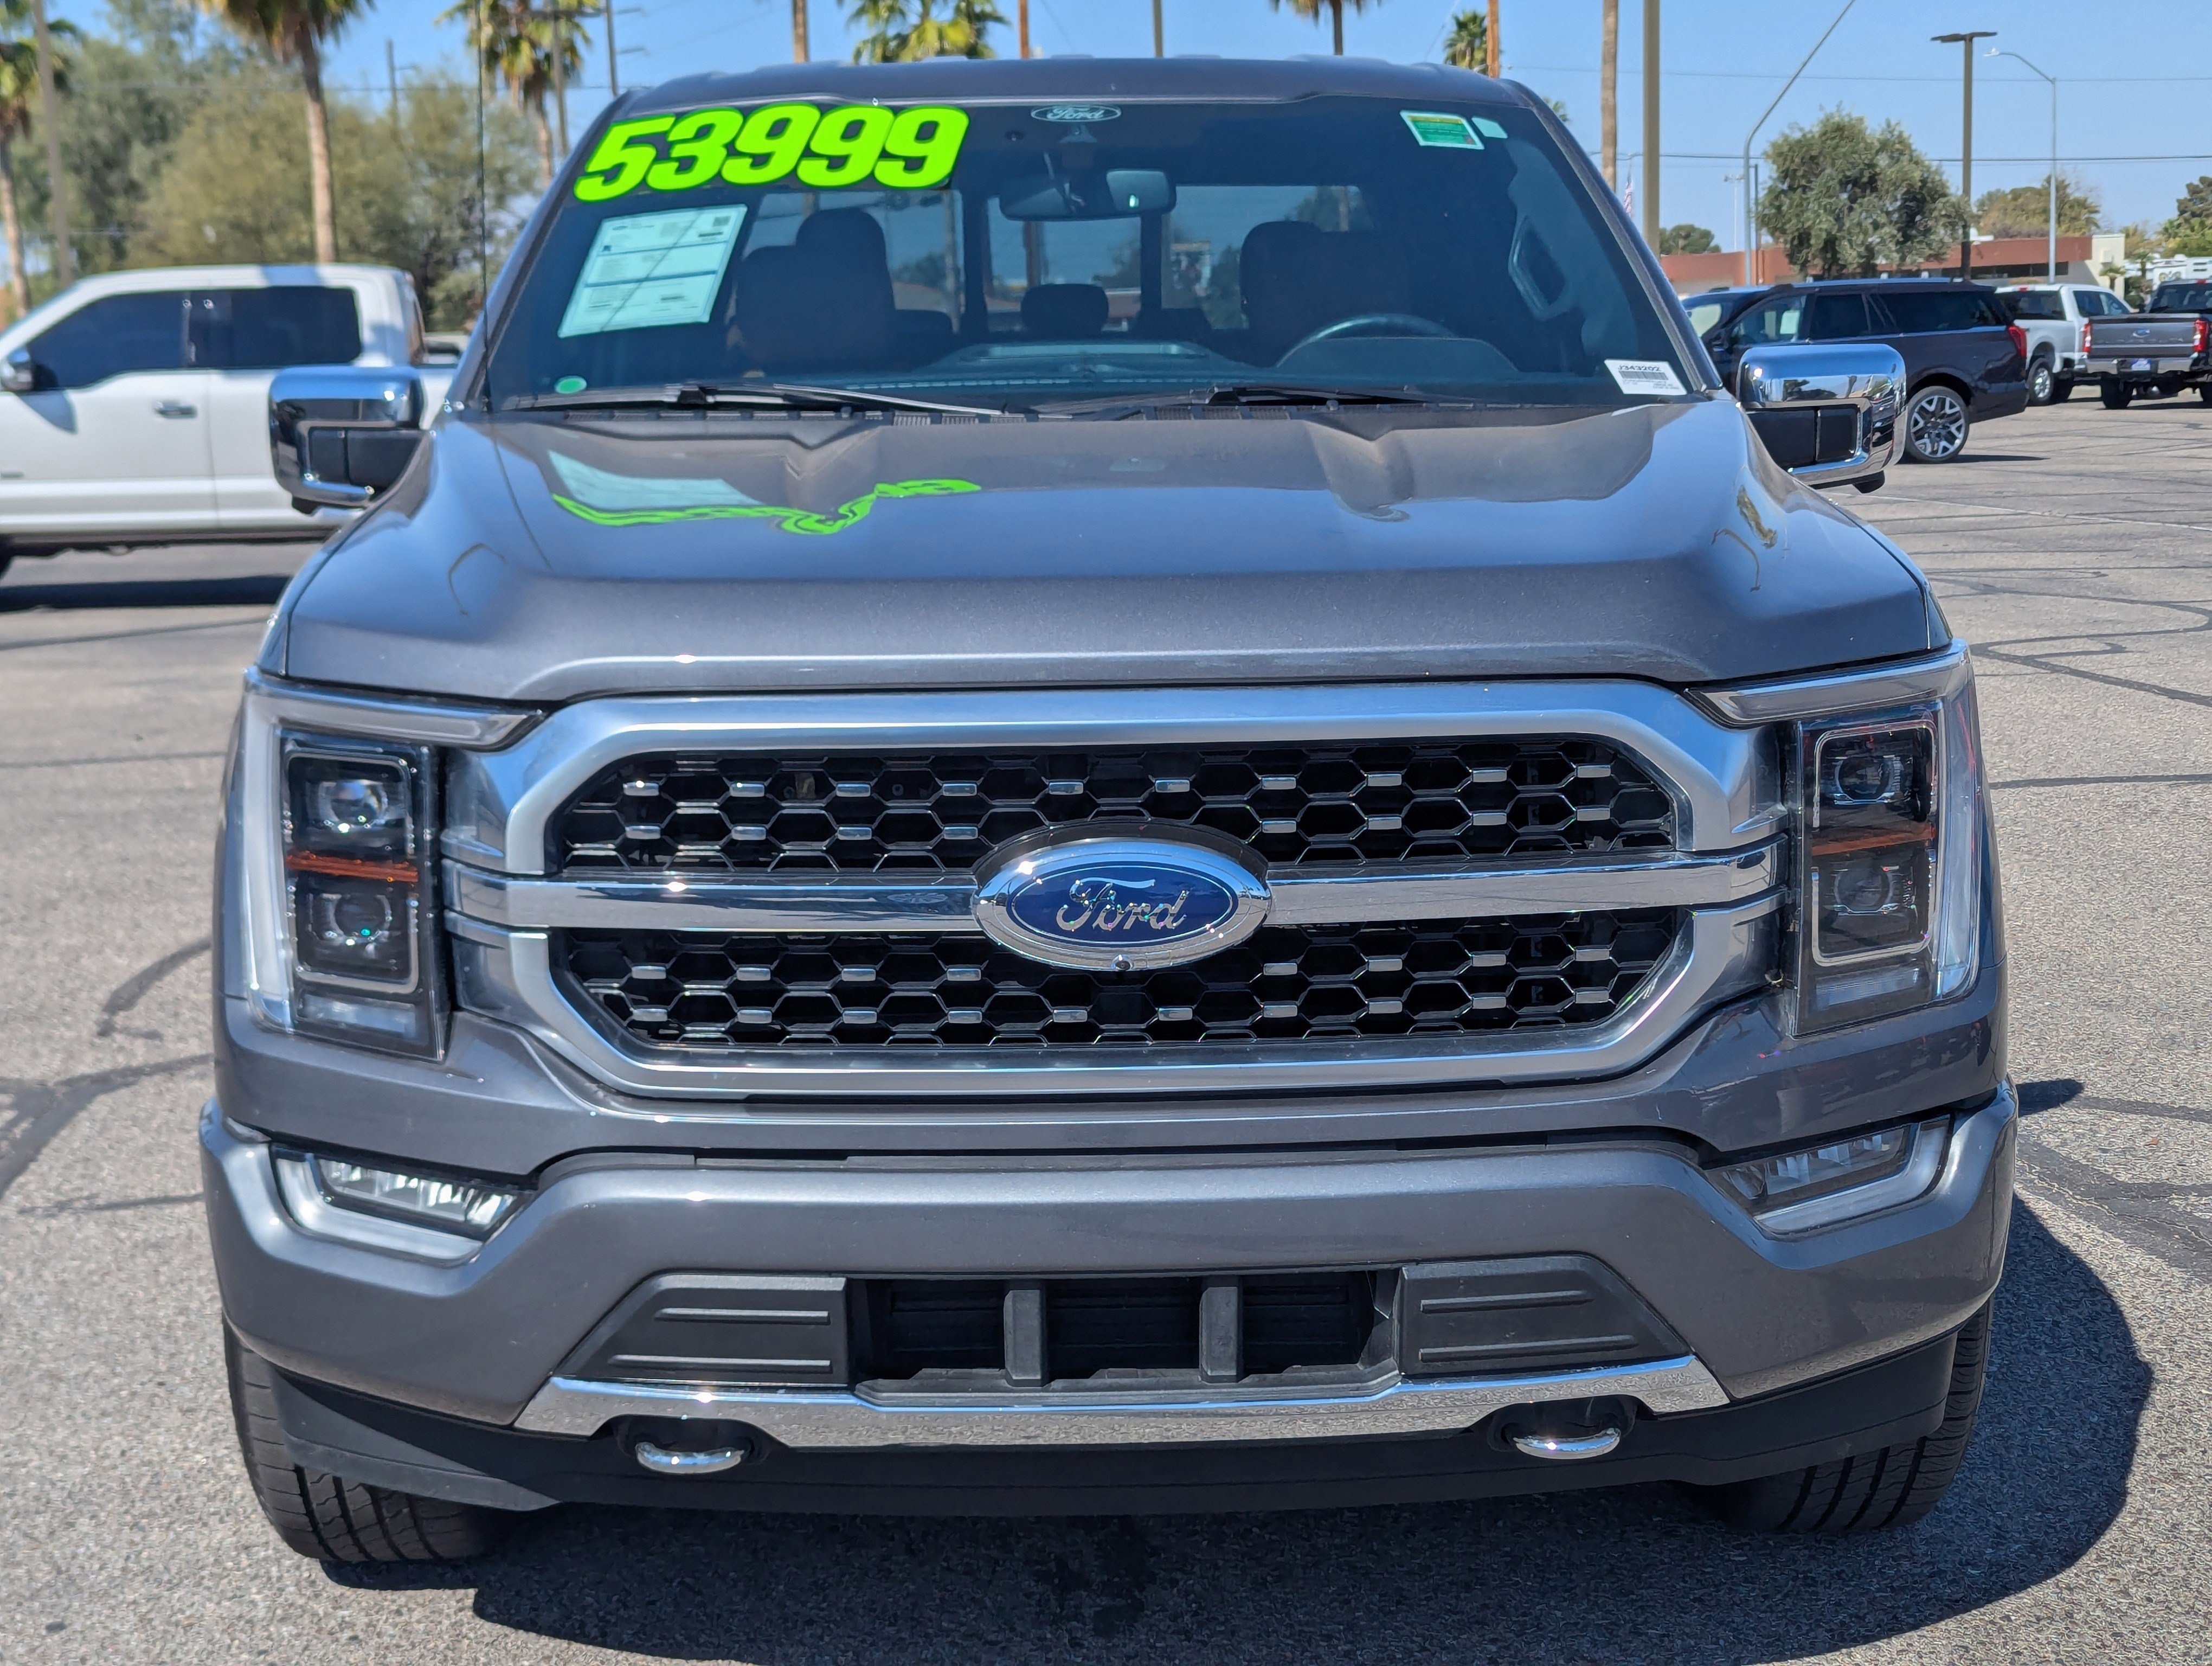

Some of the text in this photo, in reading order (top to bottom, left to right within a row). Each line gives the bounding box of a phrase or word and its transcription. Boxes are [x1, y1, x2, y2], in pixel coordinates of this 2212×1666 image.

[1047, 106, 1105, 119] Ford
[574, 101, 970, 203] 53999
[1056, 877, 1189, 931] Ford
